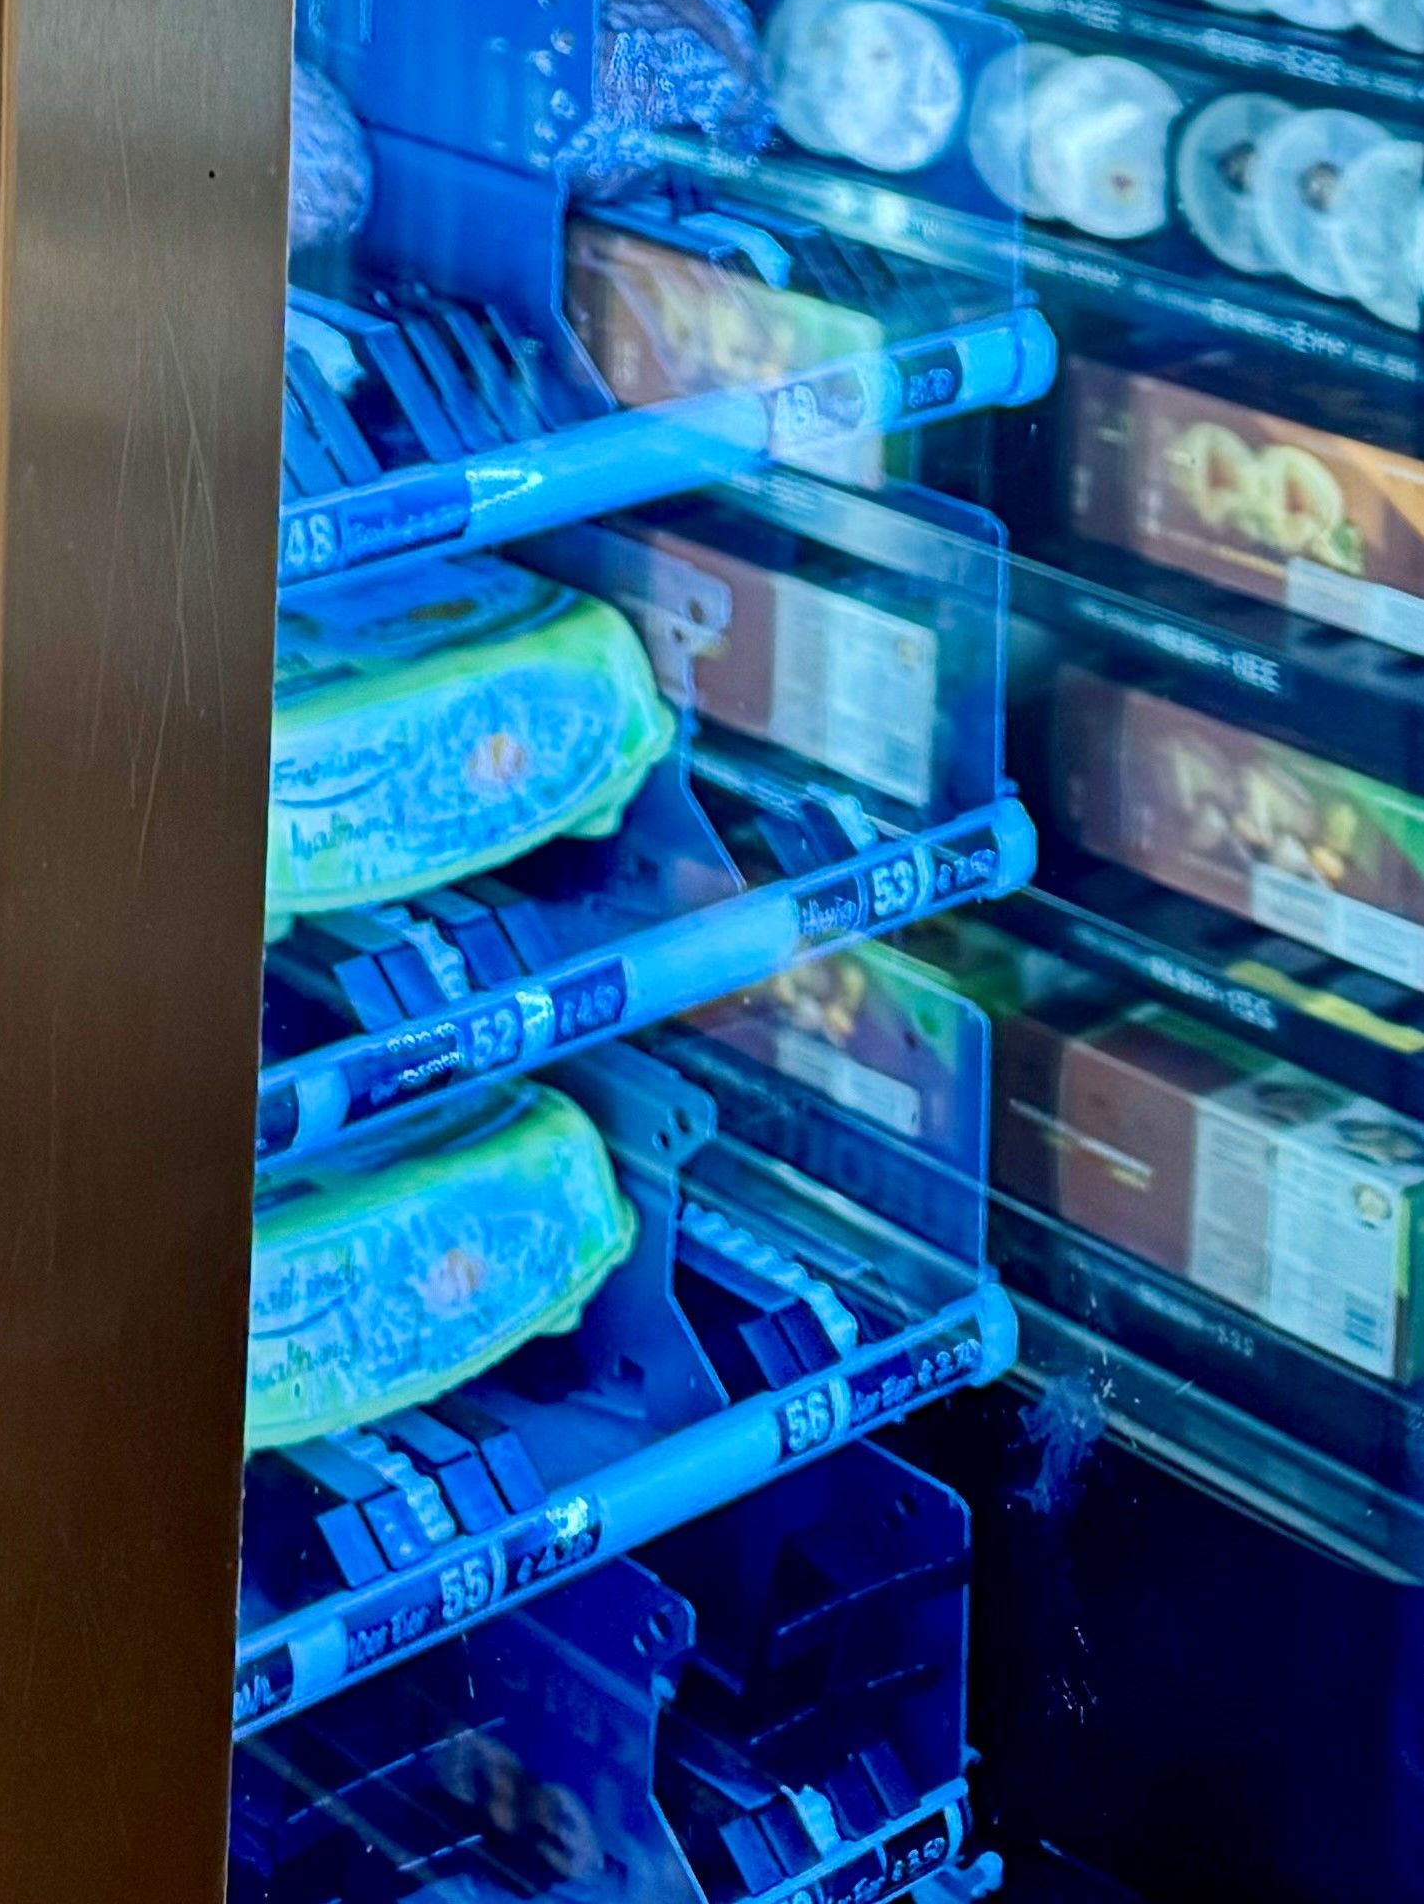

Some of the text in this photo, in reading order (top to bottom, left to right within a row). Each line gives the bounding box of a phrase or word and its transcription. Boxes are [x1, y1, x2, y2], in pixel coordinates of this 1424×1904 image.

[284, 512, 334, 570] 48
[871, 859, 915, 918] 53
[470, 1008, 516, 1068] 52
[785, 1391, 830, 1452] 56
[439, 1556, 490, 1621] 55
